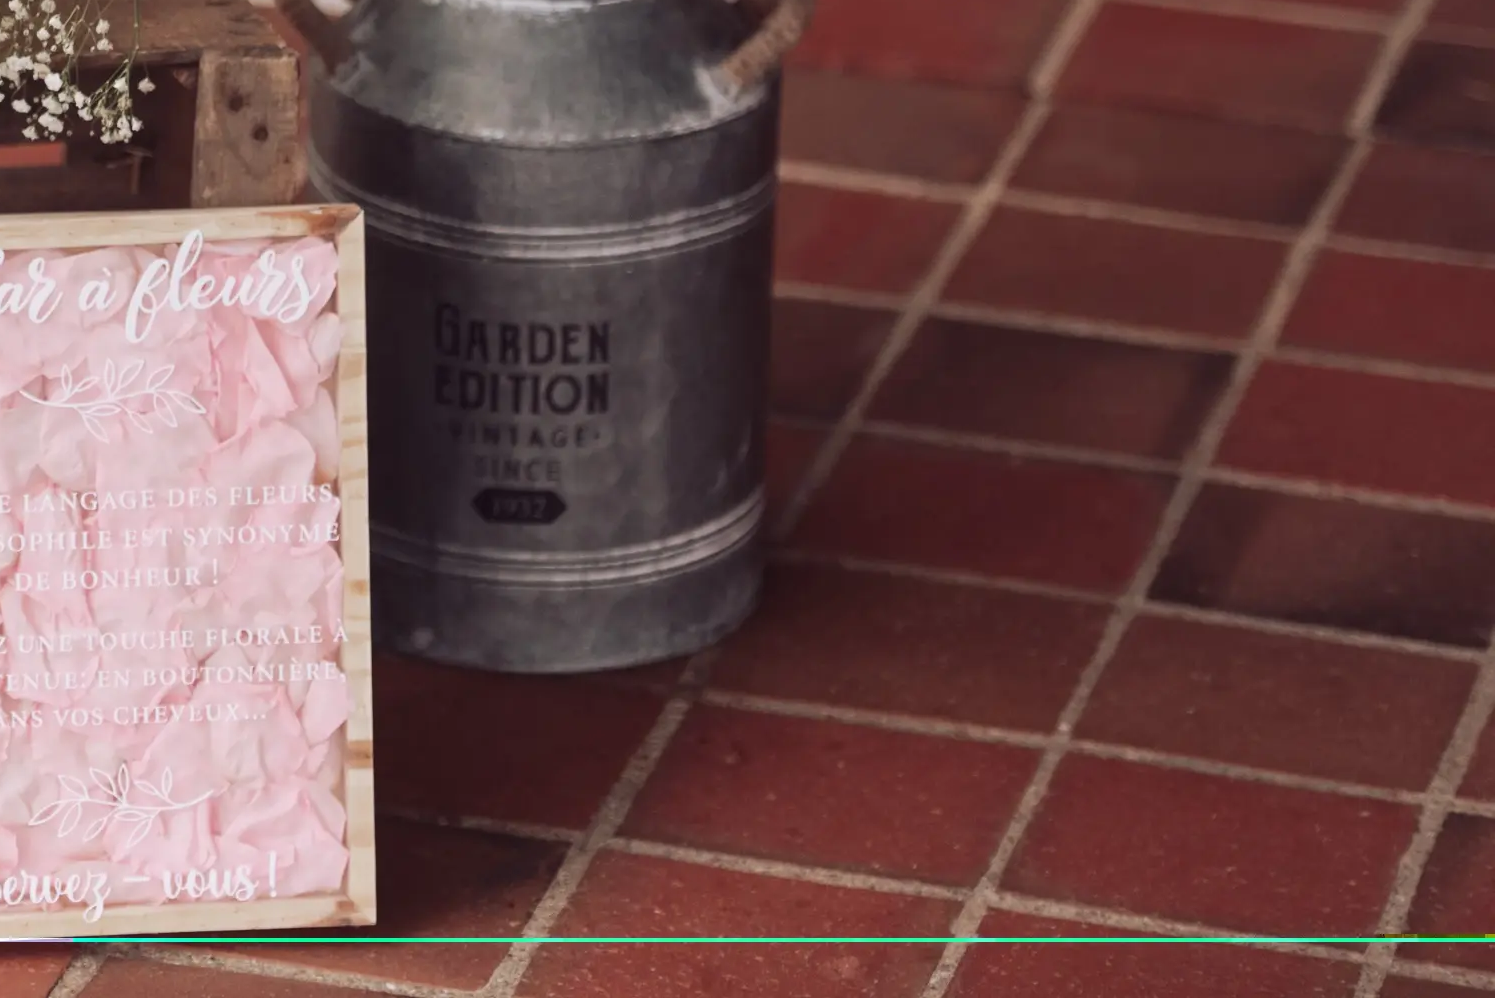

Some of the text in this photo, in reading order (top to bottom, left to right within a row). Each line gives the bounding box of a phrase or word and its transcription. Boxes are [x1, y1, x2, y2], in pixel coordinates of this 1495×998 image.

[78, 267, 117, 311] à
[125, 229, 322, 344] fleurs
[435, 302, 609, 365] GARDEN
[435, 364, 609, 415] EDITION
[474, 455, 562, 482] SINCE
[23, 490, 155, 514] LANGAGE
[169, 487, 218, 507] DES
[229, 482, 340, 508] FLEURS,
[124, 528, 173, 548] EST
[183, 521, 341, 547] SYNONYME
[14, 572, 50, 592] DE
[62, 566, 201, 592] BONHEUR
[19, 632, 74, 654] UNE
[85, 629, 195, 651] TOUCHE
[206, 625, 324, 647] FLORALE
[332, 618, 350, 643] À
[98, 669, 131, 689] EN
[143, 657, 347, 688] BOUTONNIÈRE,
[53, 706, 105, 727] VOS
[113, 702, 268, 726] CHEVEUX...
[163, 864, 260, 901] vous
